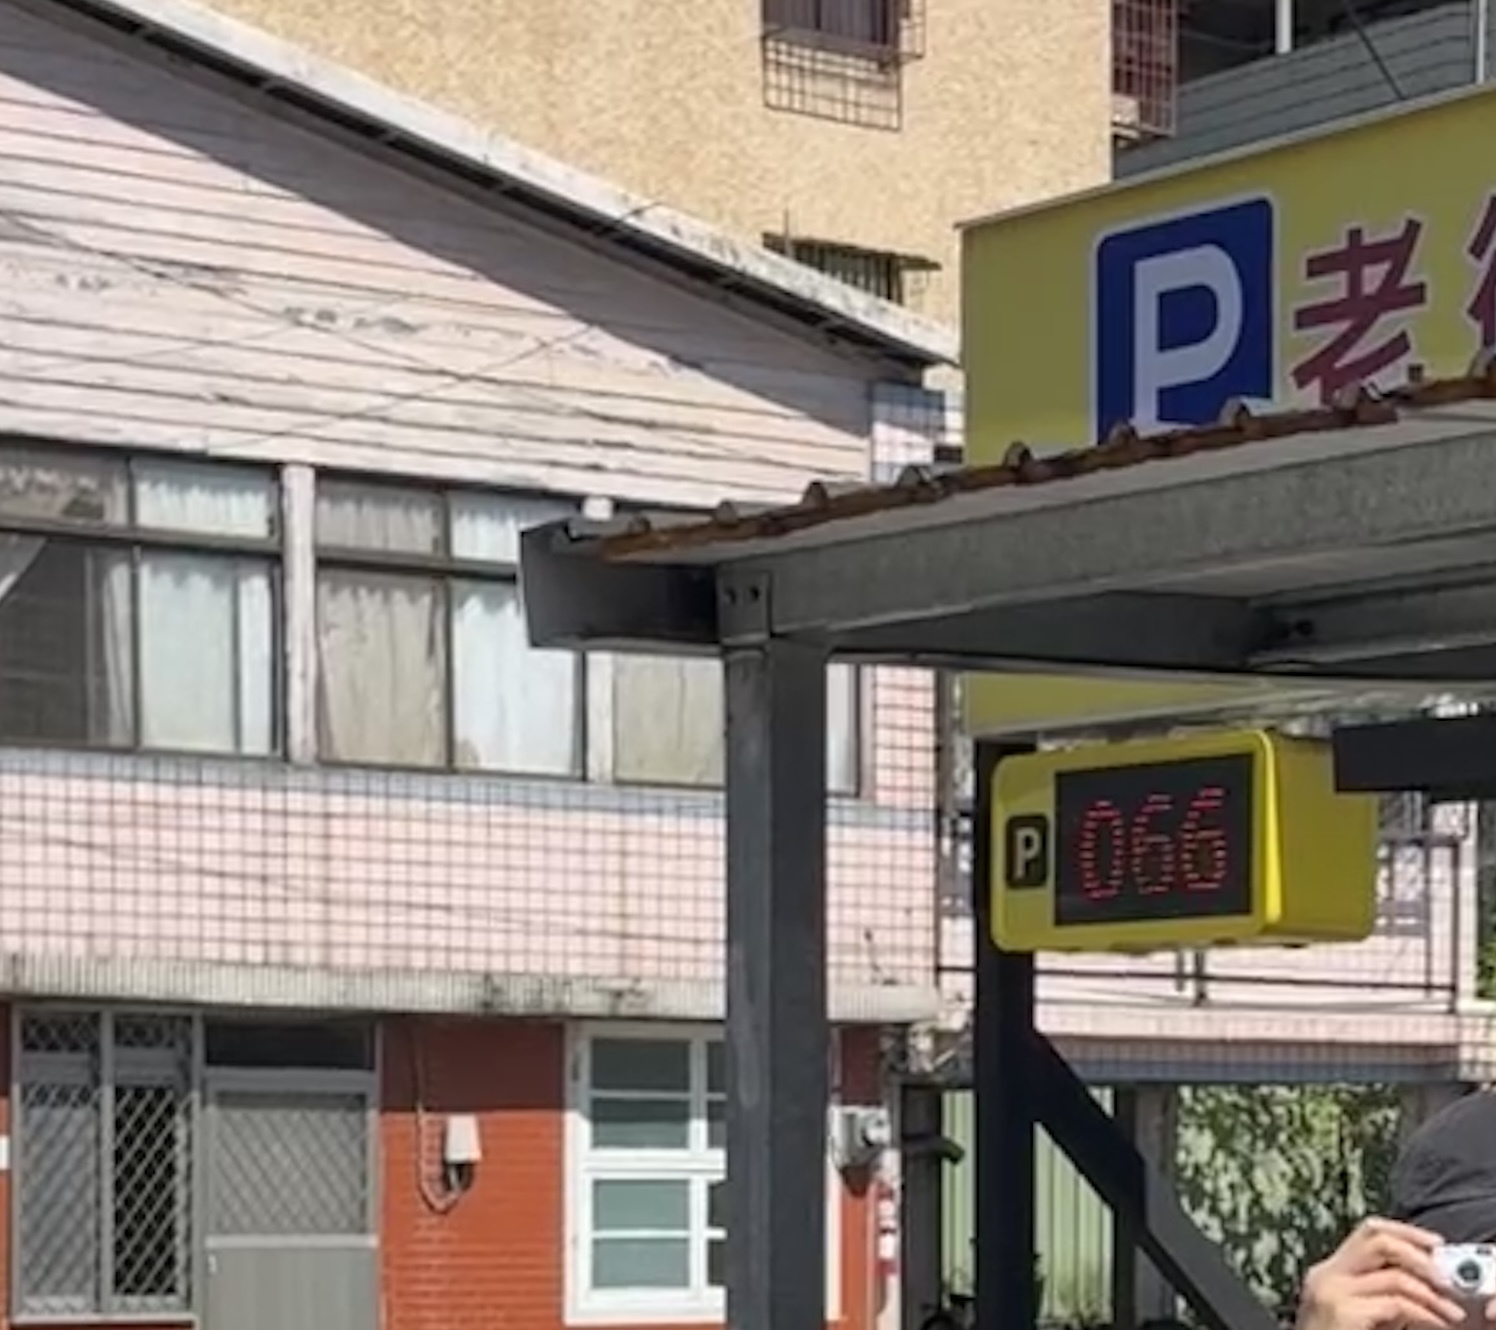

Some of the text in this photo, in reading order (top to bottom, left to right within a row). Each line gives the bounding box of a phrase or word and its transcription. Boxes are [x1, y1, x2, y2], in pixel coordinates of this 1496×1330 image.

[1134, 242, 1244, 432] P
[1013, 787, 1228, 900] P 066
